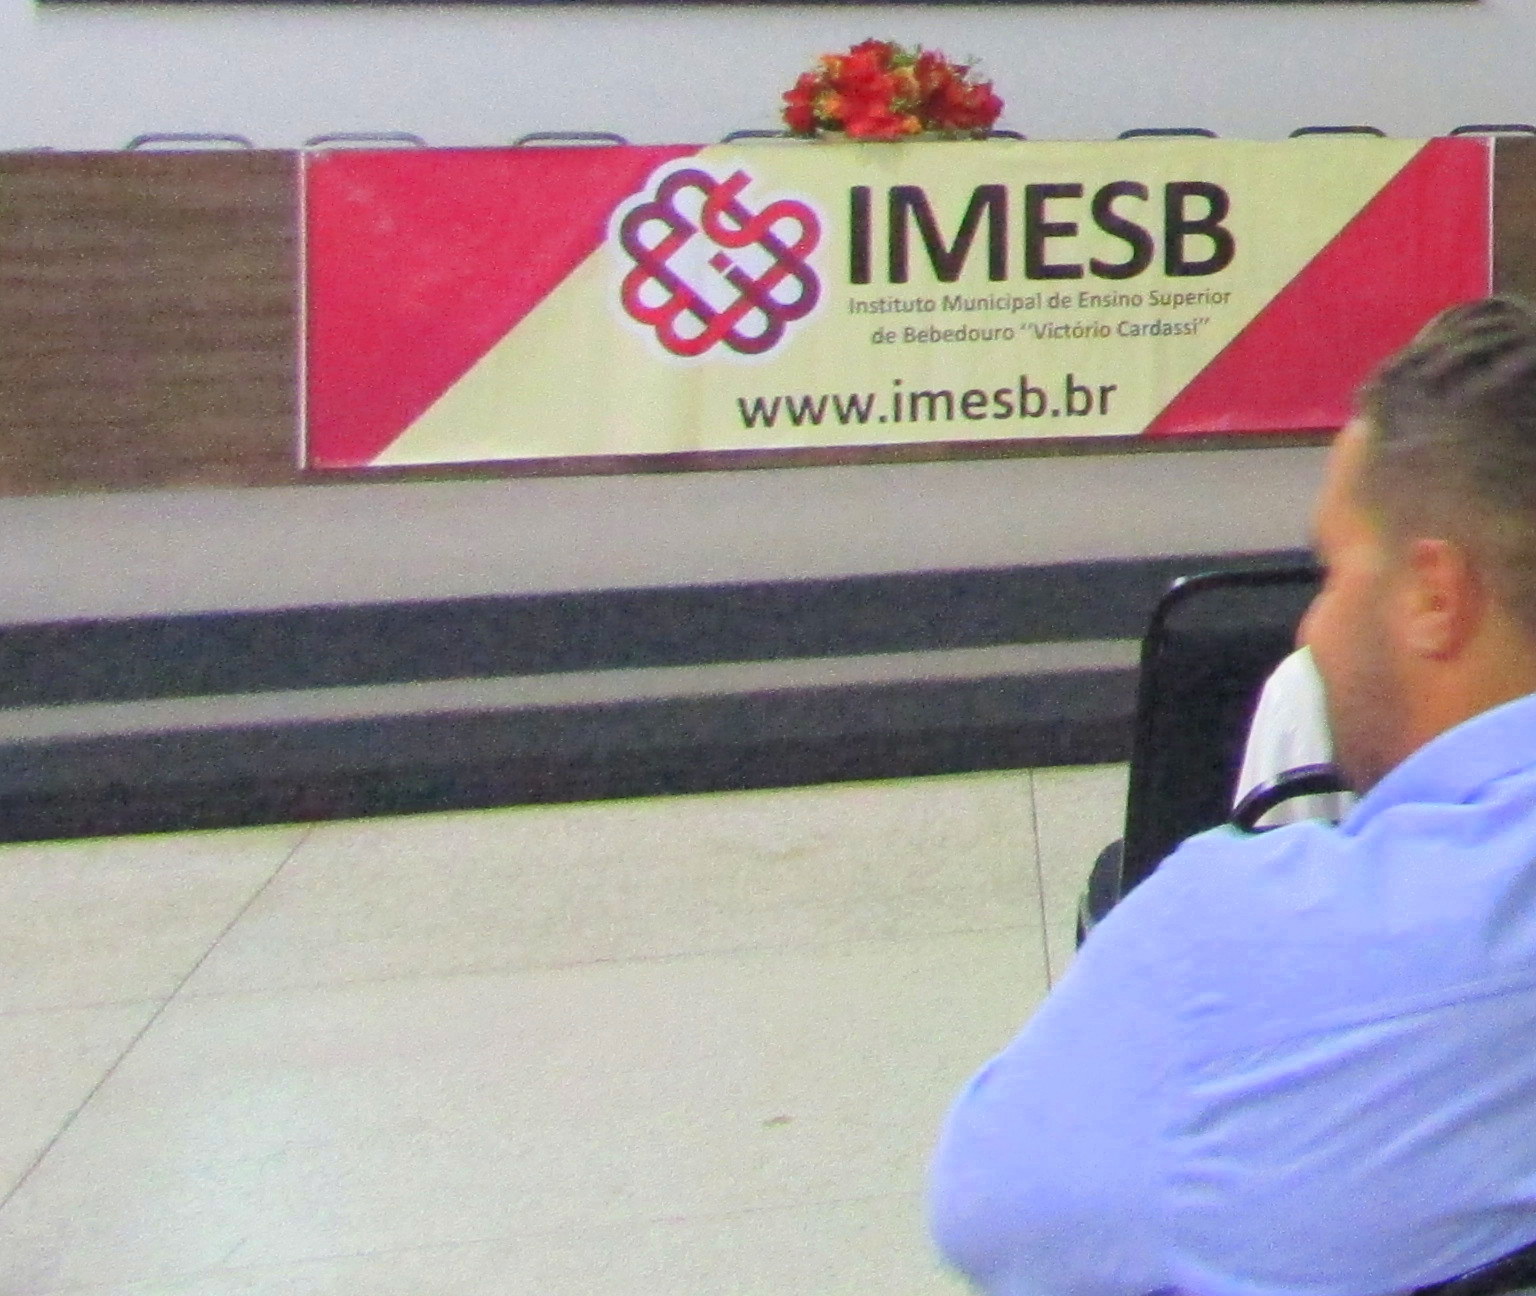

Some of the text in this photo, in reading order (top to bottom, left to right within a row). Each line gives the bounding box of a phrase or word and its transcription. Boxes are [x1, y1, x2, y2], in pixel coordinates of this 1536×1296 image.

[850, 180, 1236, 284] IMESB
[849, 288, 1232, 315] Instituto Municipal de Ensino Superior
[871, 325, 897, 345] de
[903, 323, 1015, 343] Bebedouro
[738, 373, 1117, 429] www.imesb.br
